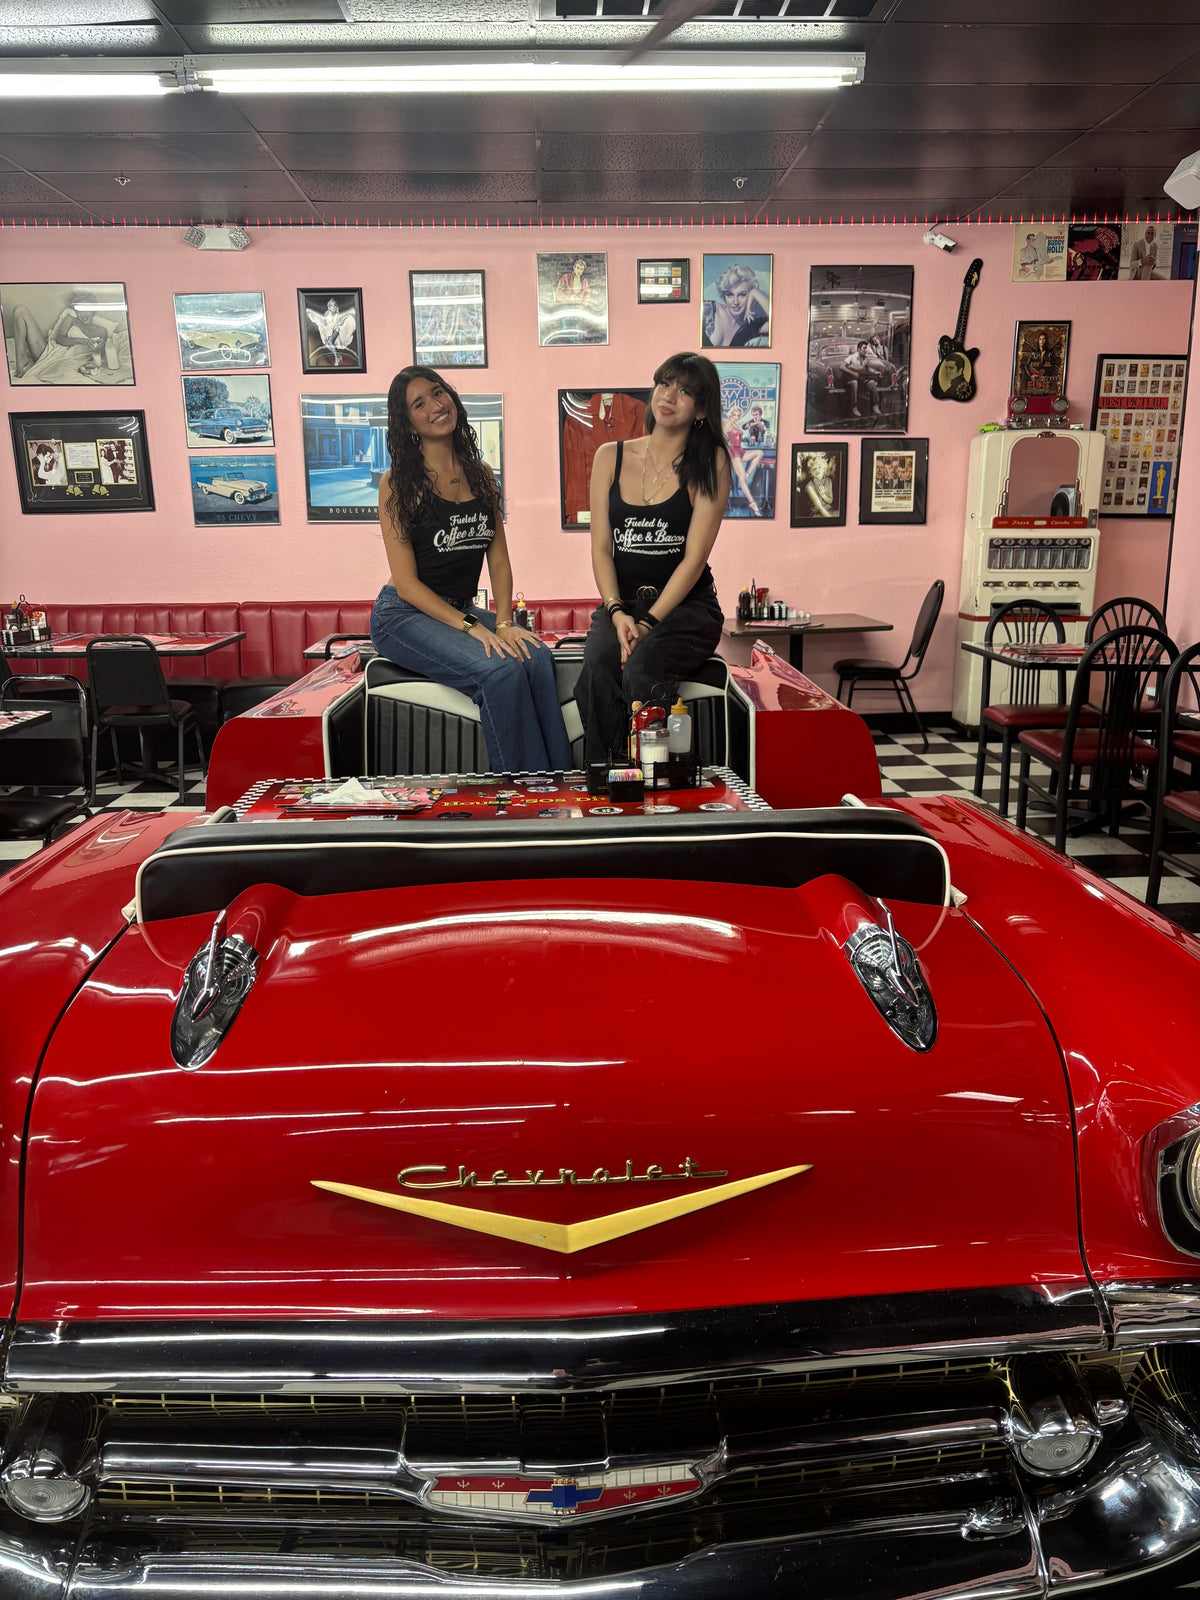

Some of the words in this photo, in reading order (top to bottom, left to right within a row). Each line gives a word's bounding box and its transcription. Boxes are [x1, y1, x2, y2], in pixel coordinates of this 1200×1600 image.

[1027, 381, 1050, 389] ELVIS
[1100, 398, 1123, 407] BEST
[1126, 398, 1166, 407] PICTURE
[228, 513, 257, 521] CHEVY
[449, 513, 477, 526] Fueled
[478, 512, 488, 525] by
[624, 517, 656, 528] Fueled
[656, 518, 669, 530] by
[433, 526, 467, 547] Coffee
[467, 527, 475, 537] &
[613, 527, 644, 547] Coffee
[644, 531, 653, 542] &
[654, 529, 685, 544] Bacon
[397, 1156, 729, 1189] Chevrolet
